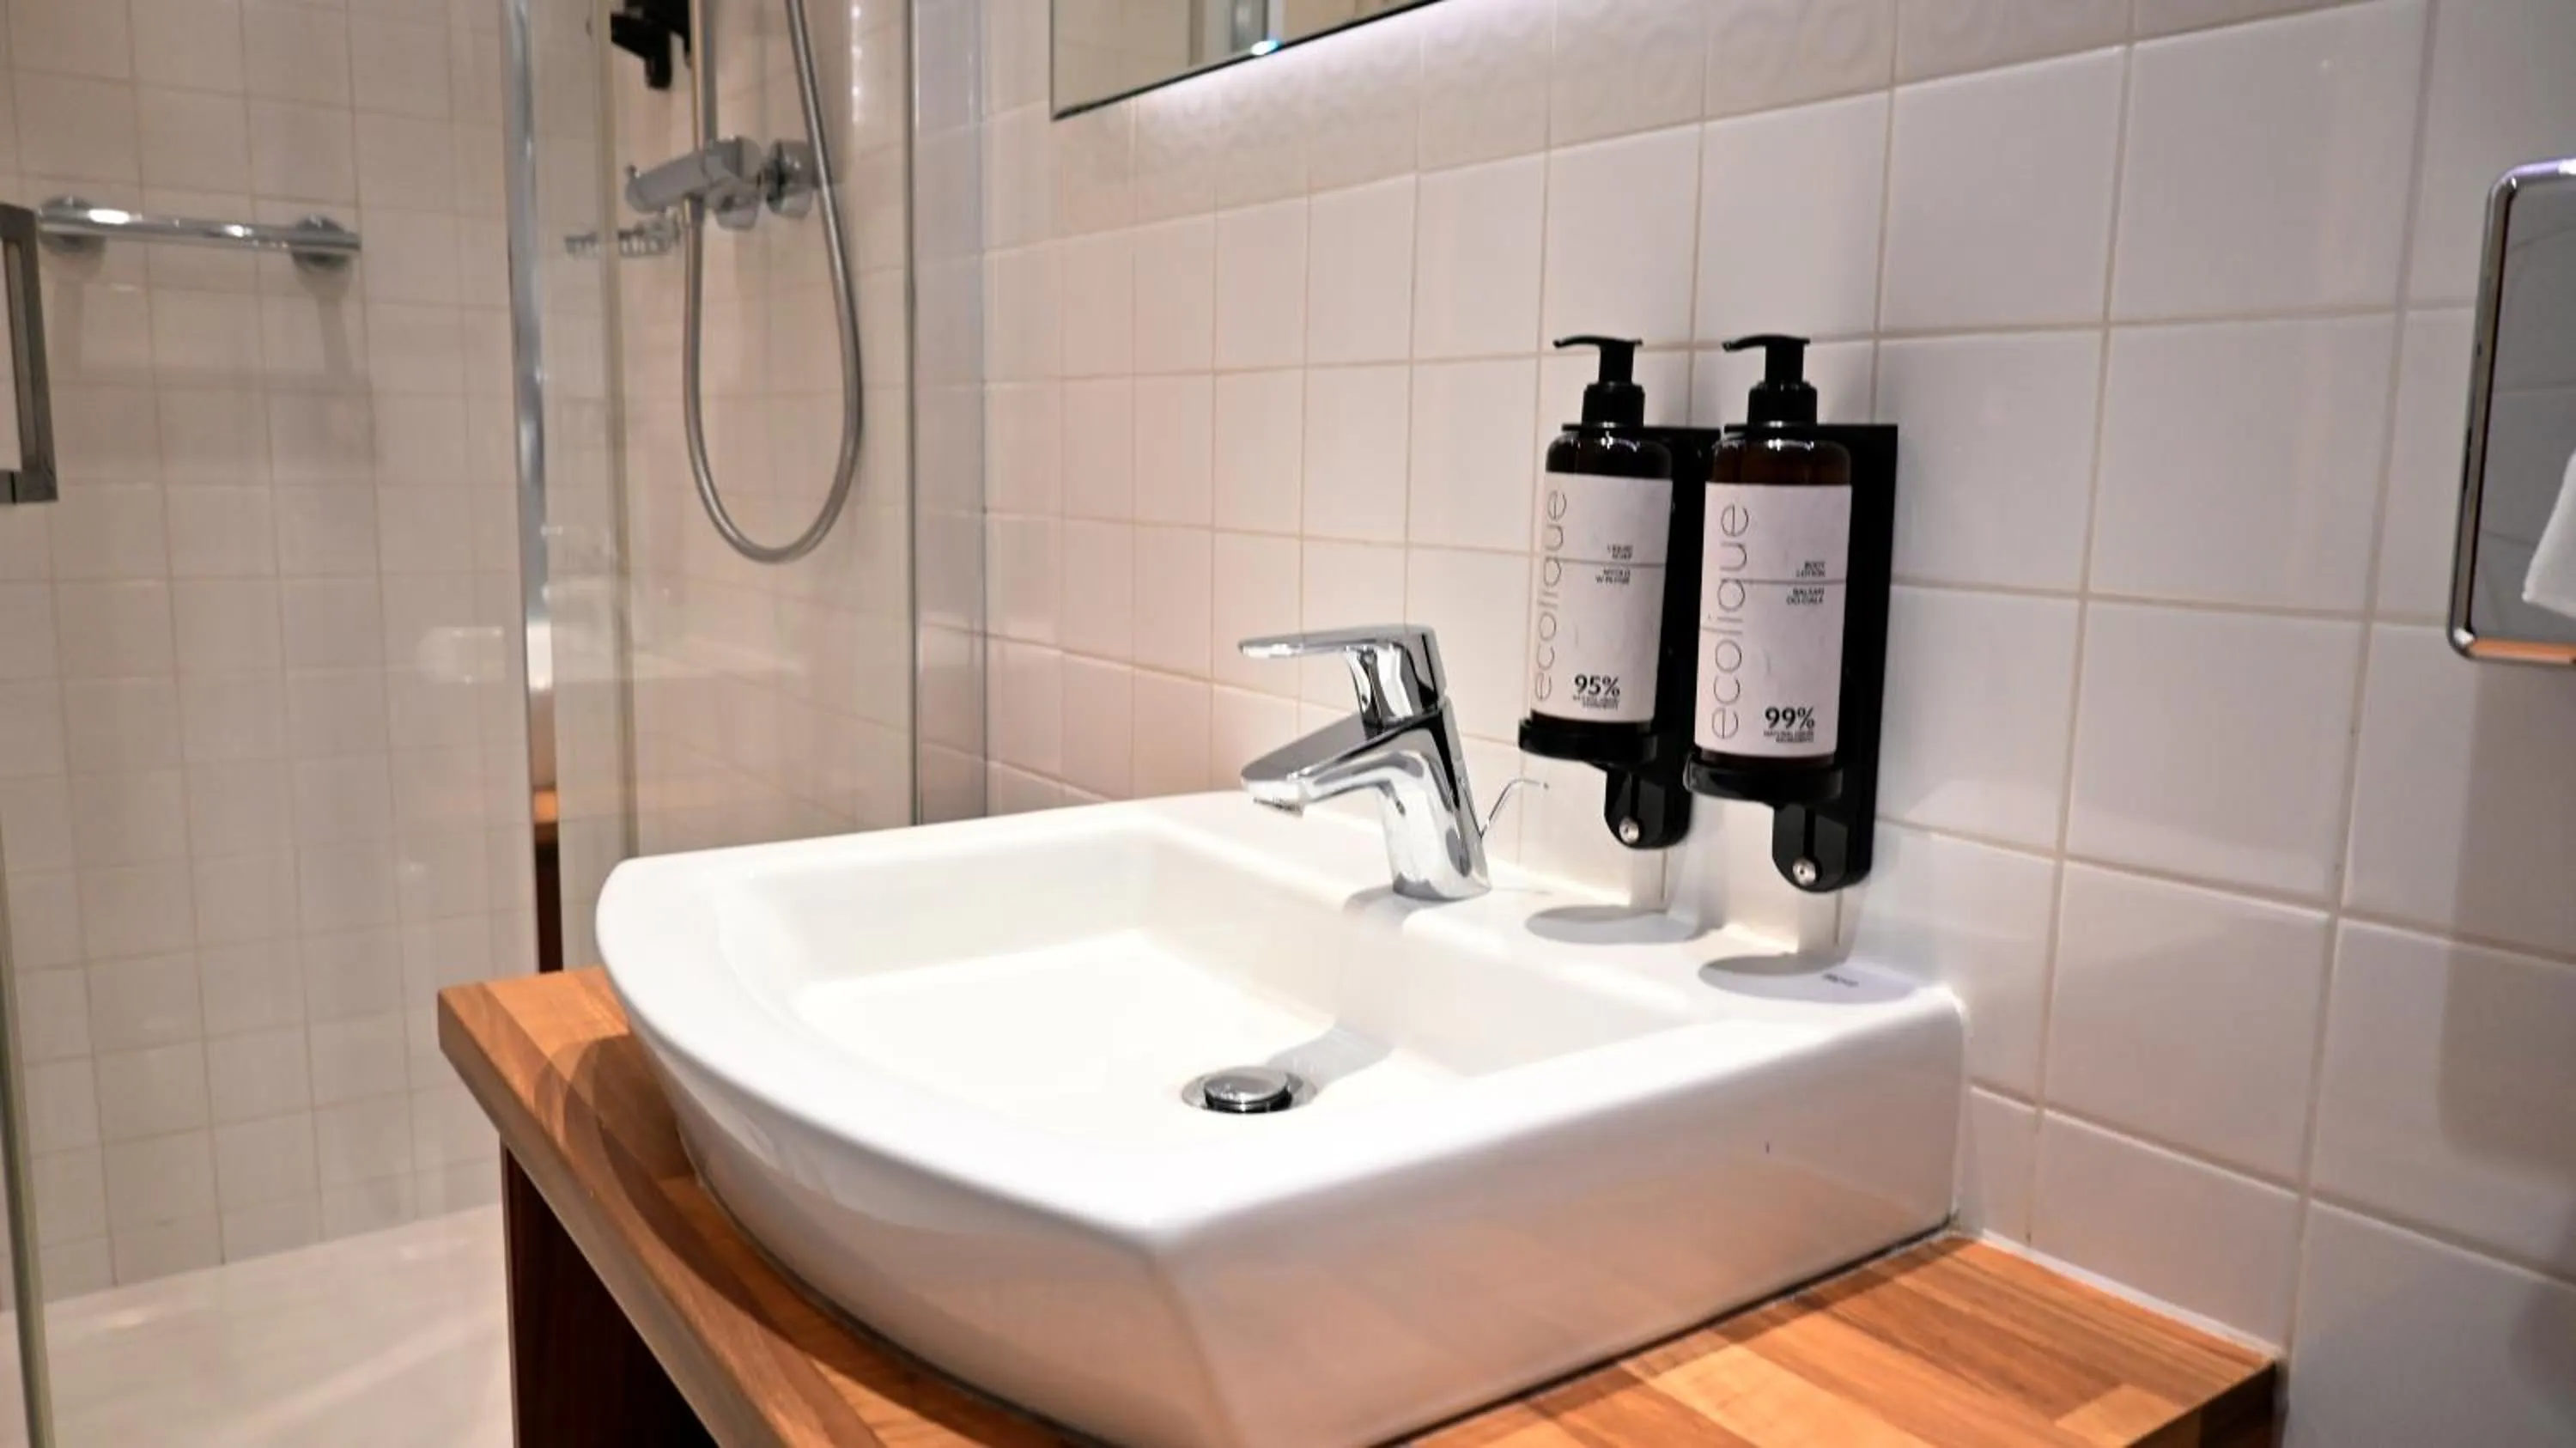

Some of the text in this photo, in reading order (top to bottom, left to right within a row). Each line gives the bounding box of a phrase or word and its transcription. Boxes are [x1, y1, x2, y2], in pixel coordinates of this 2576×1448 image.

[1534, 490, 1567, 702] ecolique
[1702, 503, 1749, 739] ecolique
[1575, 673, 1620, 697] 95%
[1765, 706, 1815, 729] 99%
